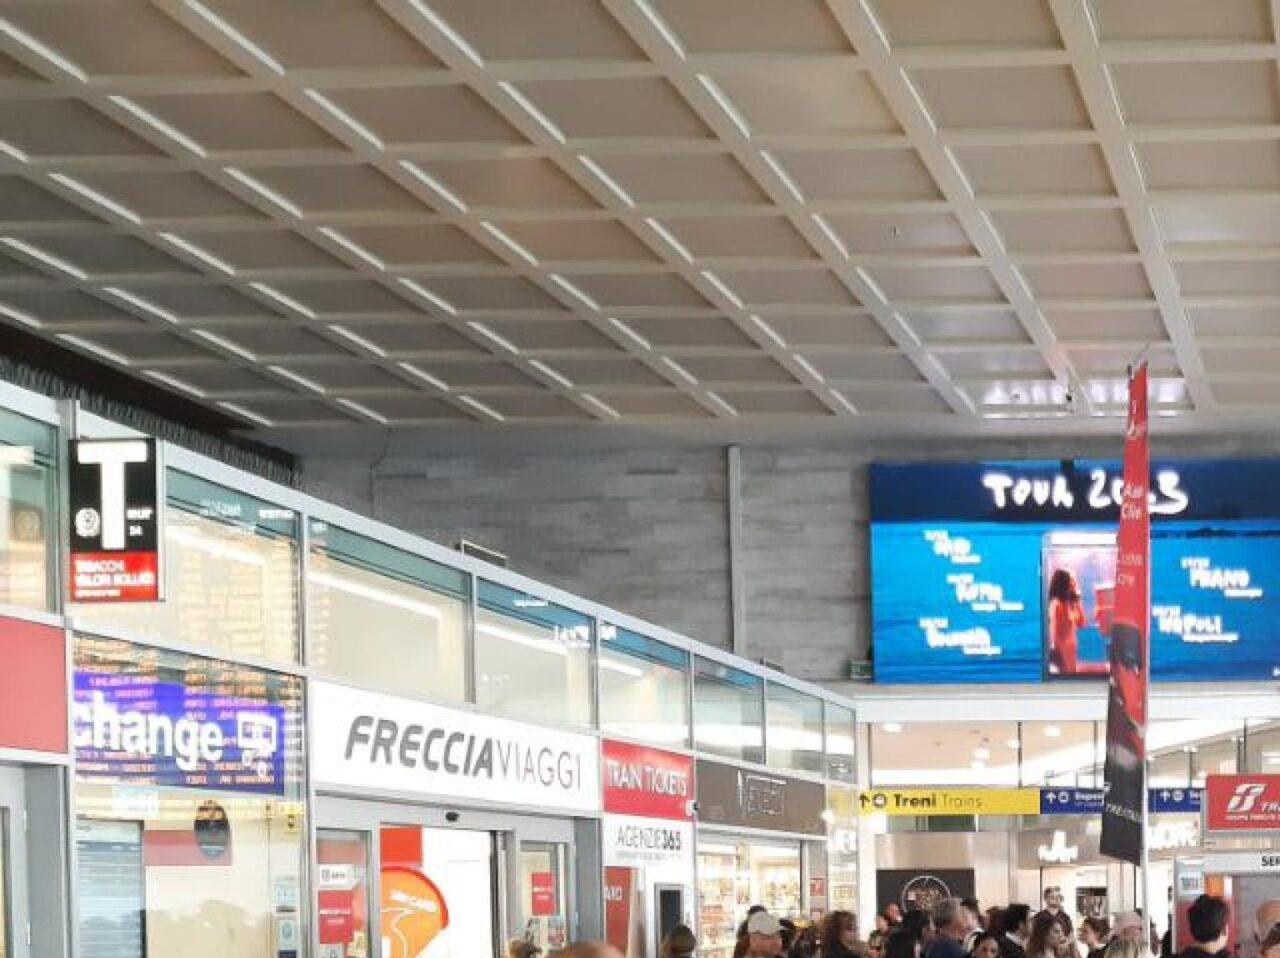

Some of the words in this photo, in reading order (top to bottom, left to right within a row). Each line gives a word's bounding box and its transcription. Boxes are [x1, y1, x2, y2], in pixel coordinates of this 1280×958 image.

[77, 441, 147, 549] T
[607, 760, 642, 791] TRAIN
[645, 766, 688, 797] TICKETS
[894, 793, 936, 807] Treni
[941, 793, 983, 807] Trains
